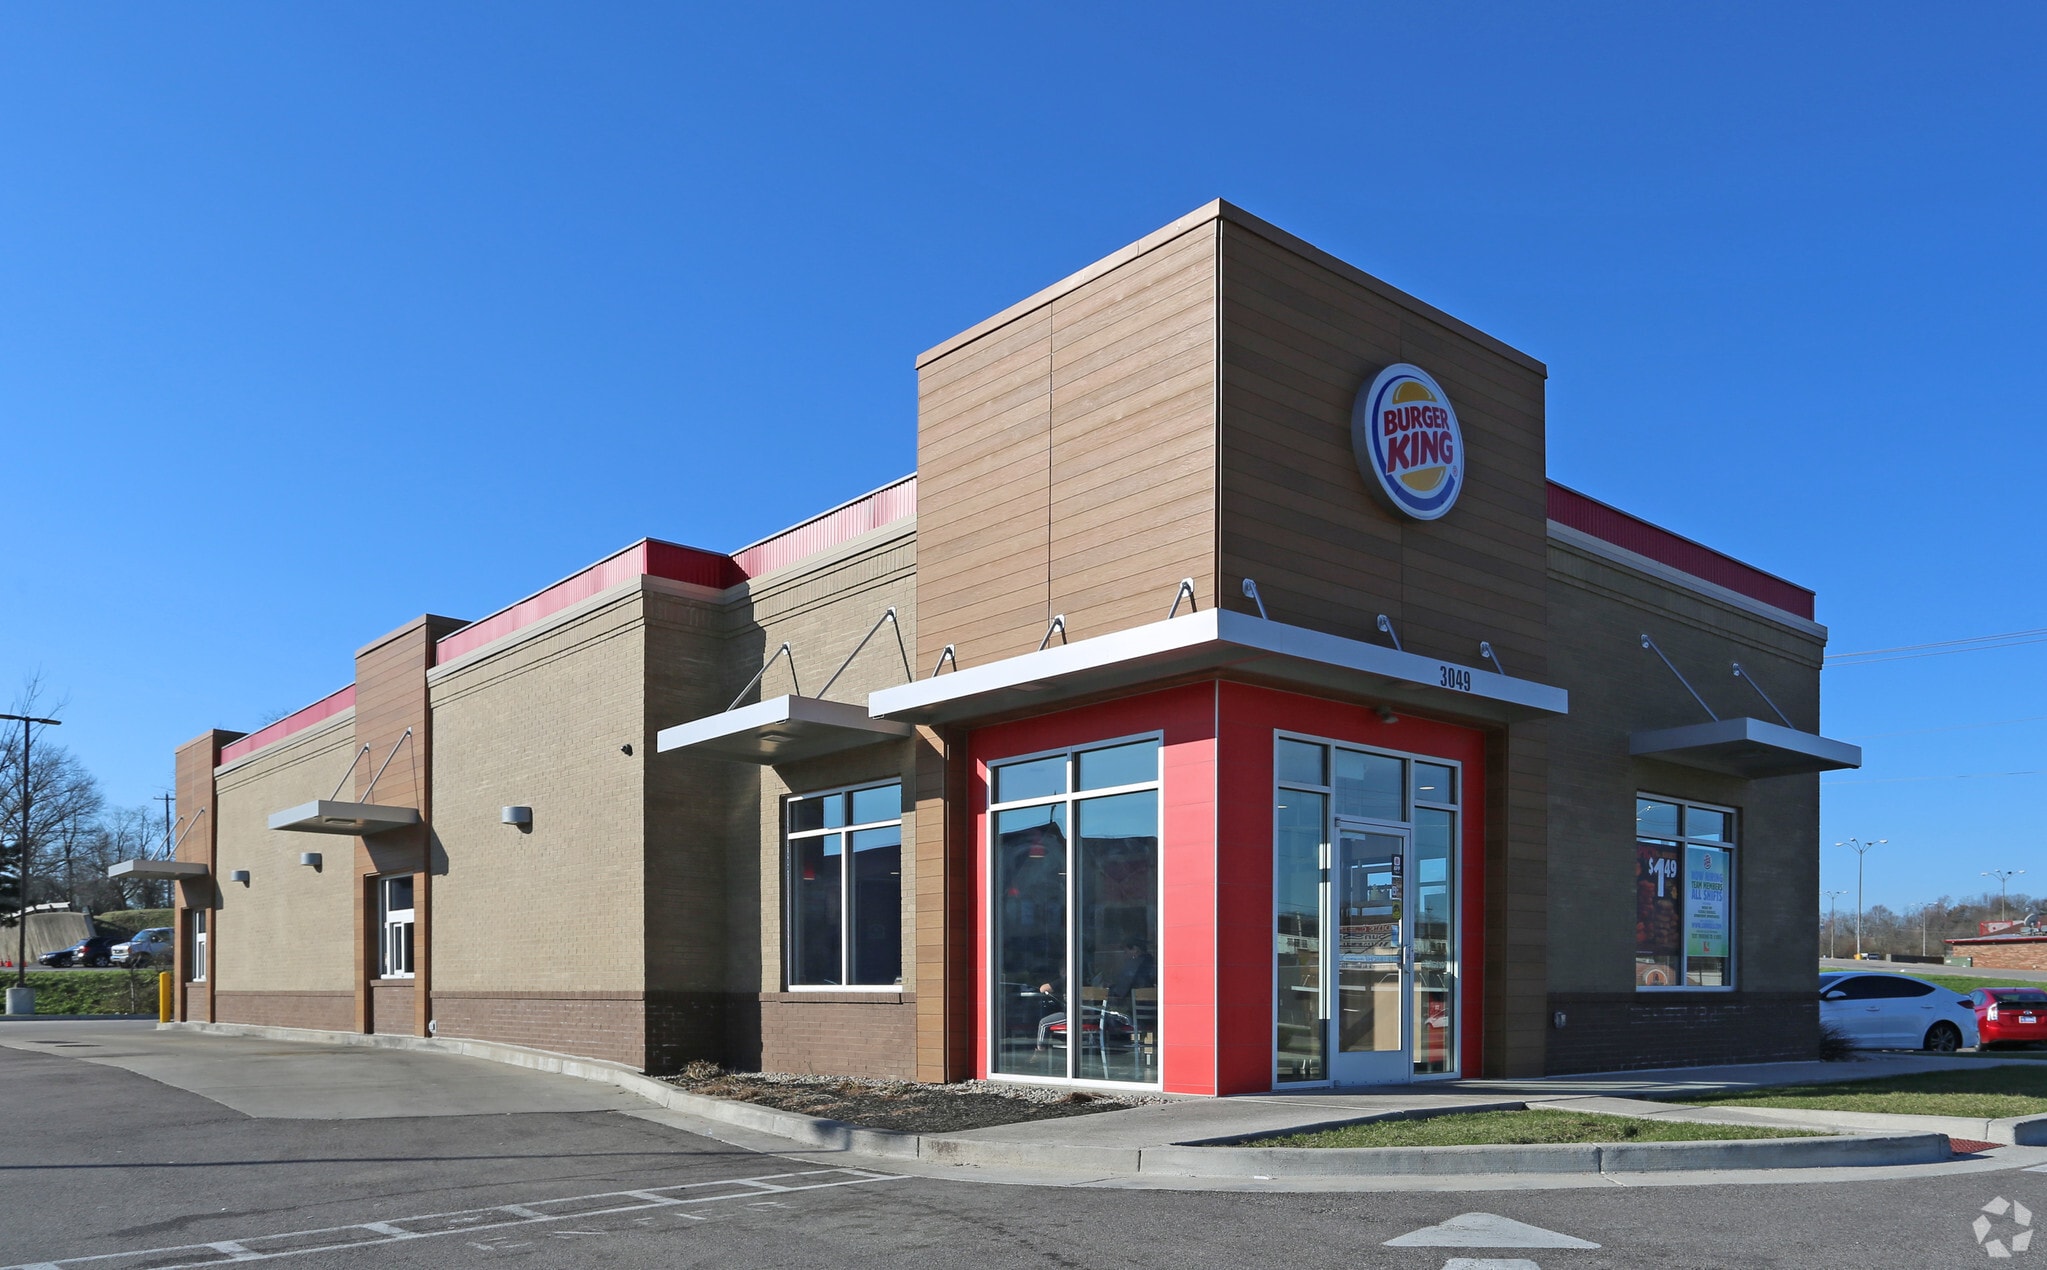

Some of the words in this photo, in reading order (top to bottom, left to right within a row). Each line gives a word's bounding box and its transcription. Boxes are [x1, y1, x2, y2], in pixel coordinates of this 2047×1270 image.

[1384, 405, 1449, 437] BURGER
[1387, 430, 1453, 473] KING
[1440, 666, 1470, 691] 3049
[1691, 889, 1701, 900] ALL
[1703, 889, 1723, 902] SHIFTS
